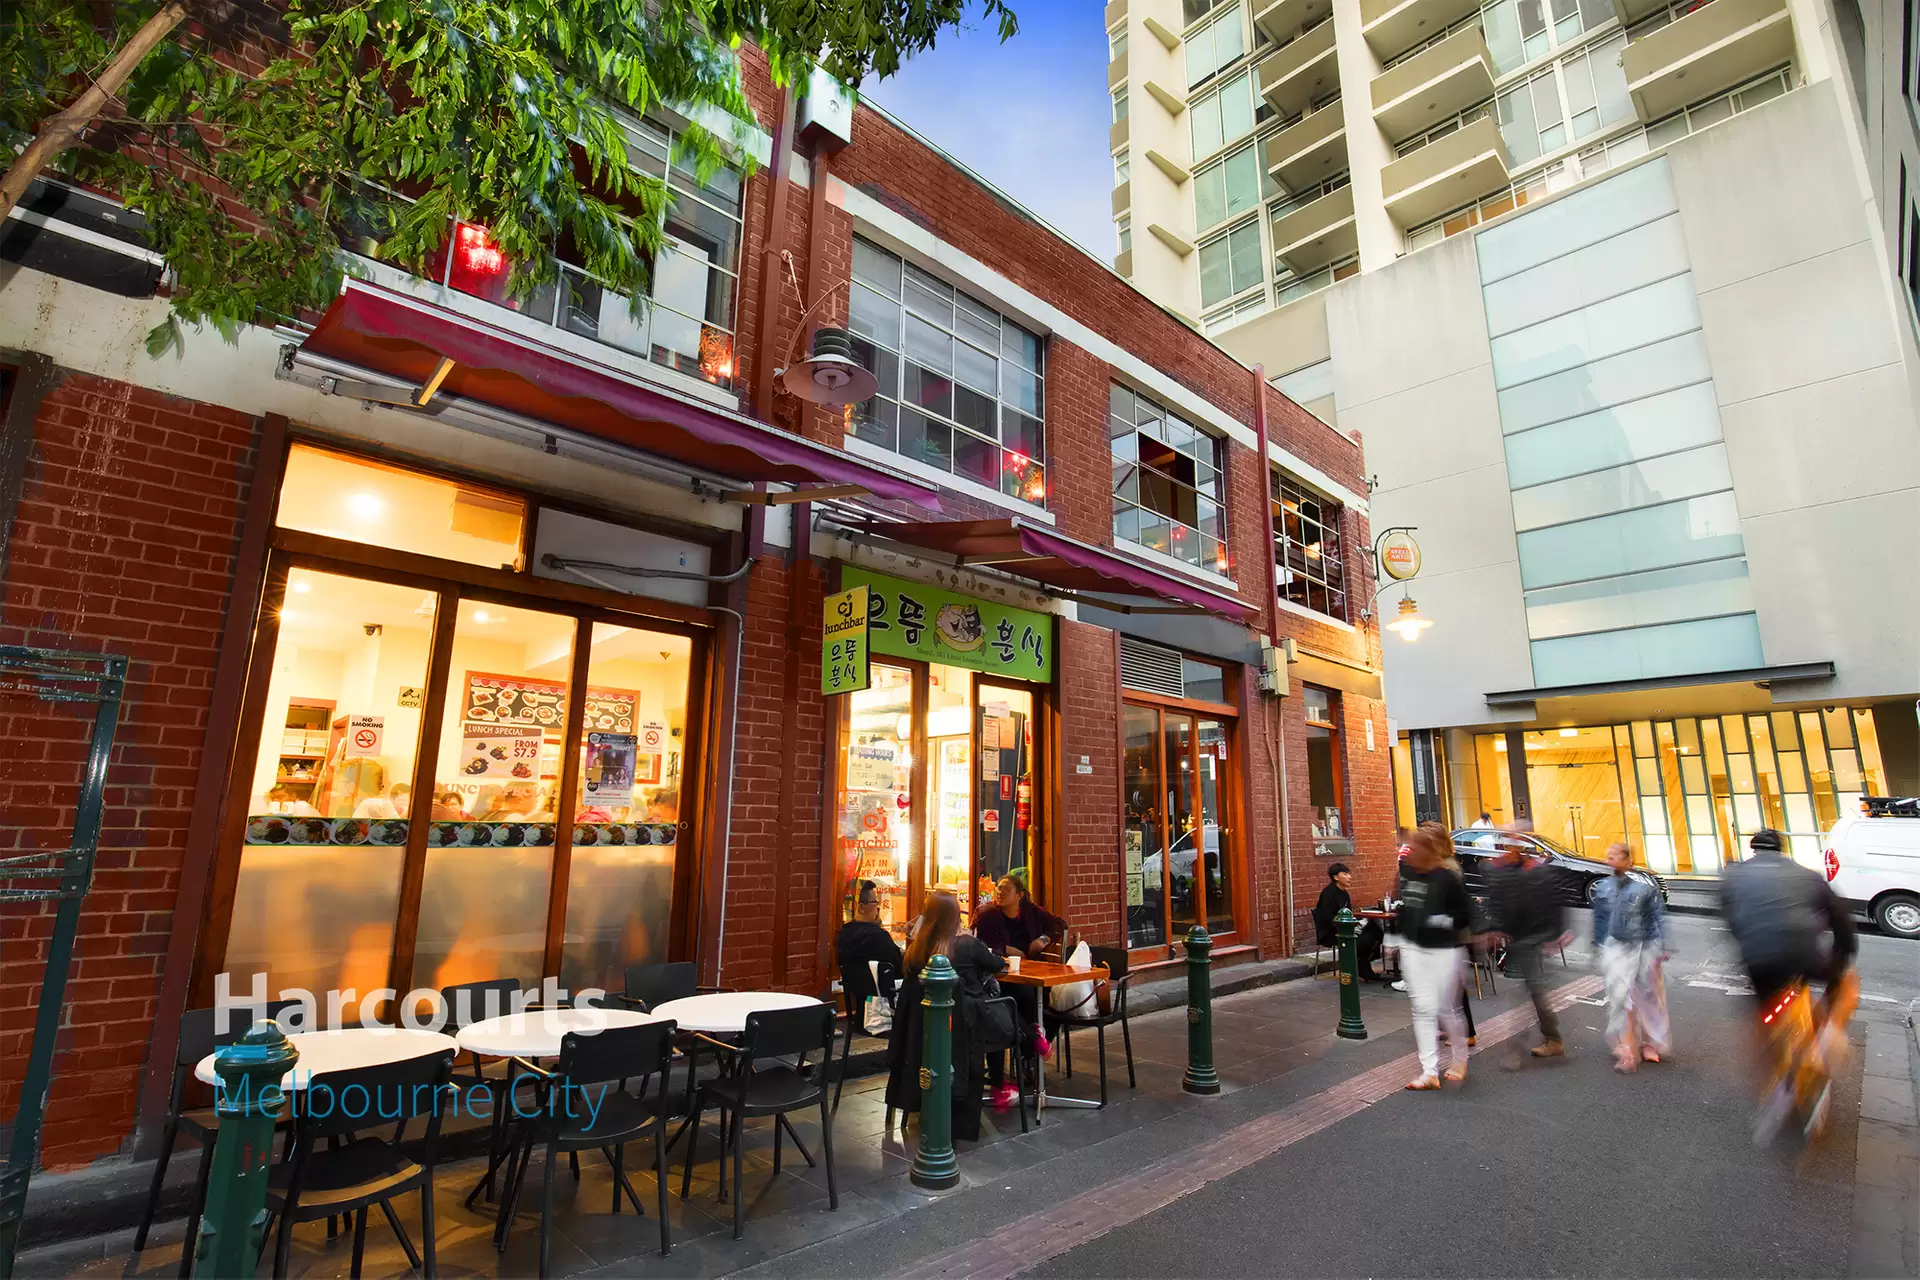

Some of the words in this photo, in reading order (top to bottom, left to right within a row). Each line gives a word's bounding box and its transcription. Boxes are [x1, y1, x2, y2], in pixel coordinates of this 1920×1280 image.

[824, 616, 865, 635] lunchbar
[991, 617, 1043, 669] 분식
[831, 639, 857, 661] 으뜸
[829, 663, 856, 687] 분식
[468, 725, 493, 734] LUNCH
[495, 727, 524, 736] SPECIAL
[515, 740, 538, 748] FROM
[513, 747, 538, 758] $7.9
[842, 836, 899, 848] lunchba
[874, 869, 897, 877] AWAY
